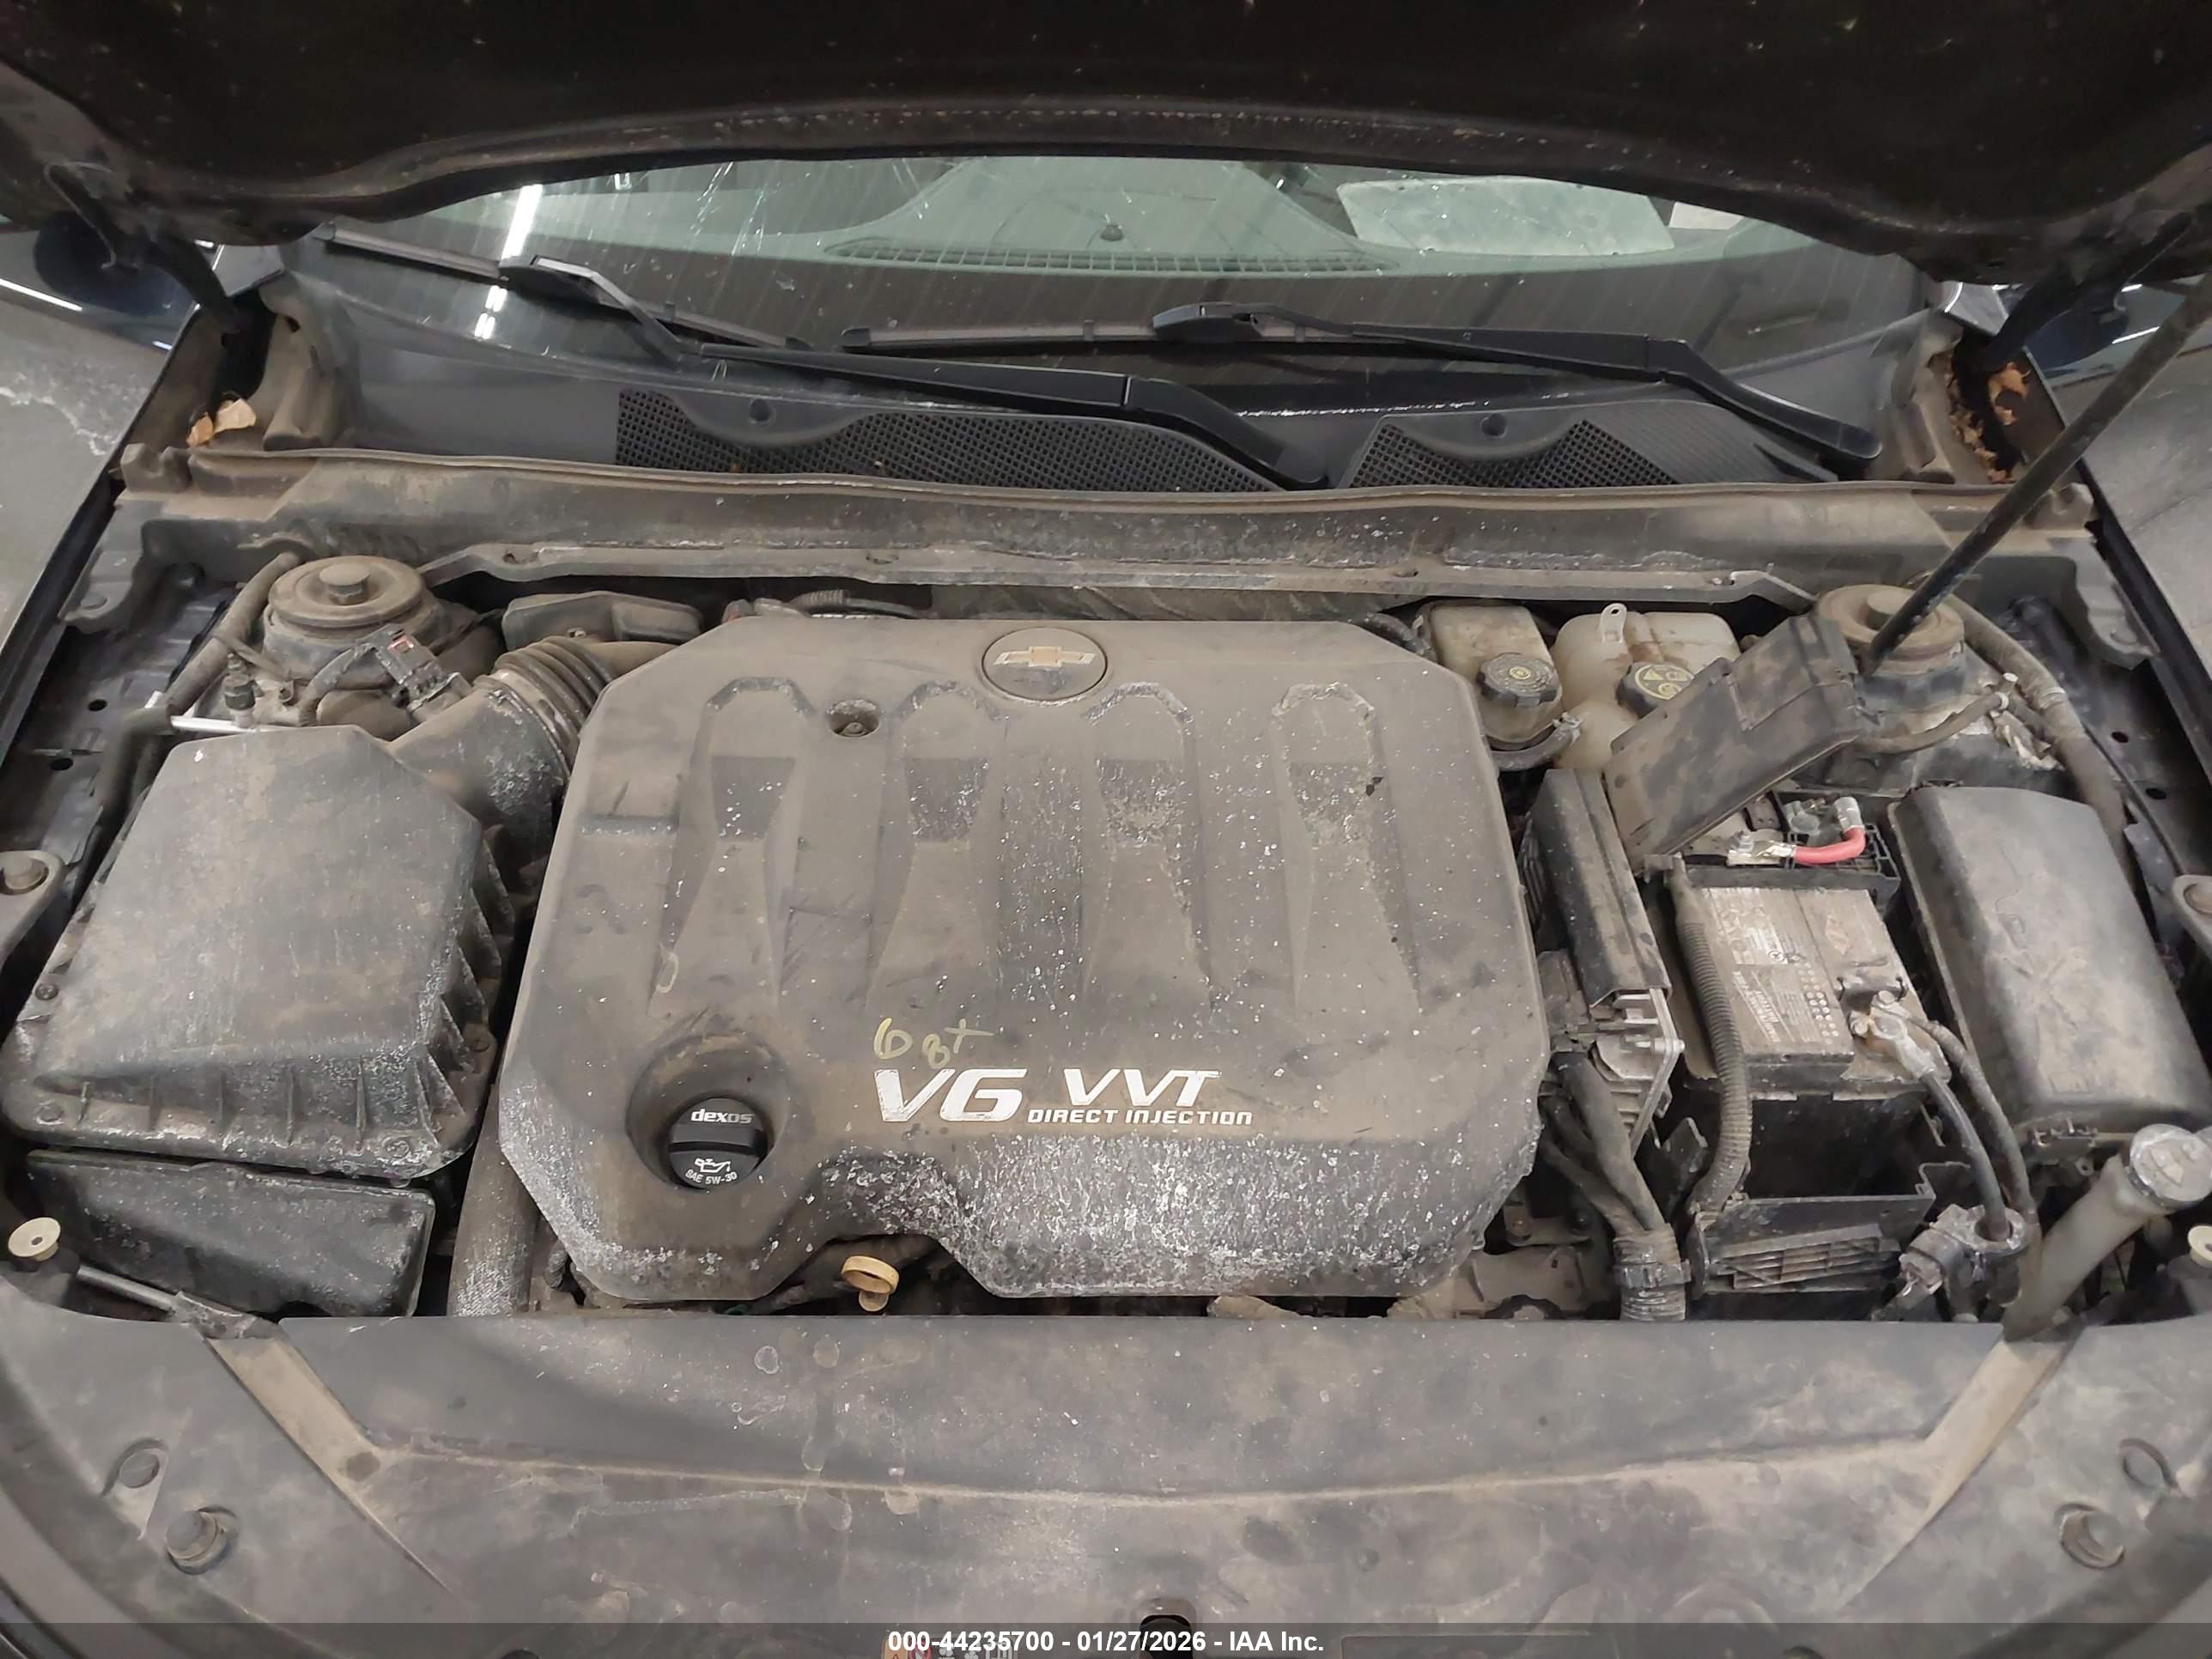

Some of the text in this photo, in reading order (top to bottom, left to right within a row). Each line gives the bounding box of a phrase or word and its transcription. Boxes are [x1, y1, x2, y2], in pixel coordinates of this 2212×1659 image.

[873, 1068, 1222, 1123] V6 VVT
[690, 1109, 756, 1124] dexos
[1027, 1109, 1253, 1126] DIRECT INJECTION
[685, 1169, 738, 1185] SAE 5W-30
